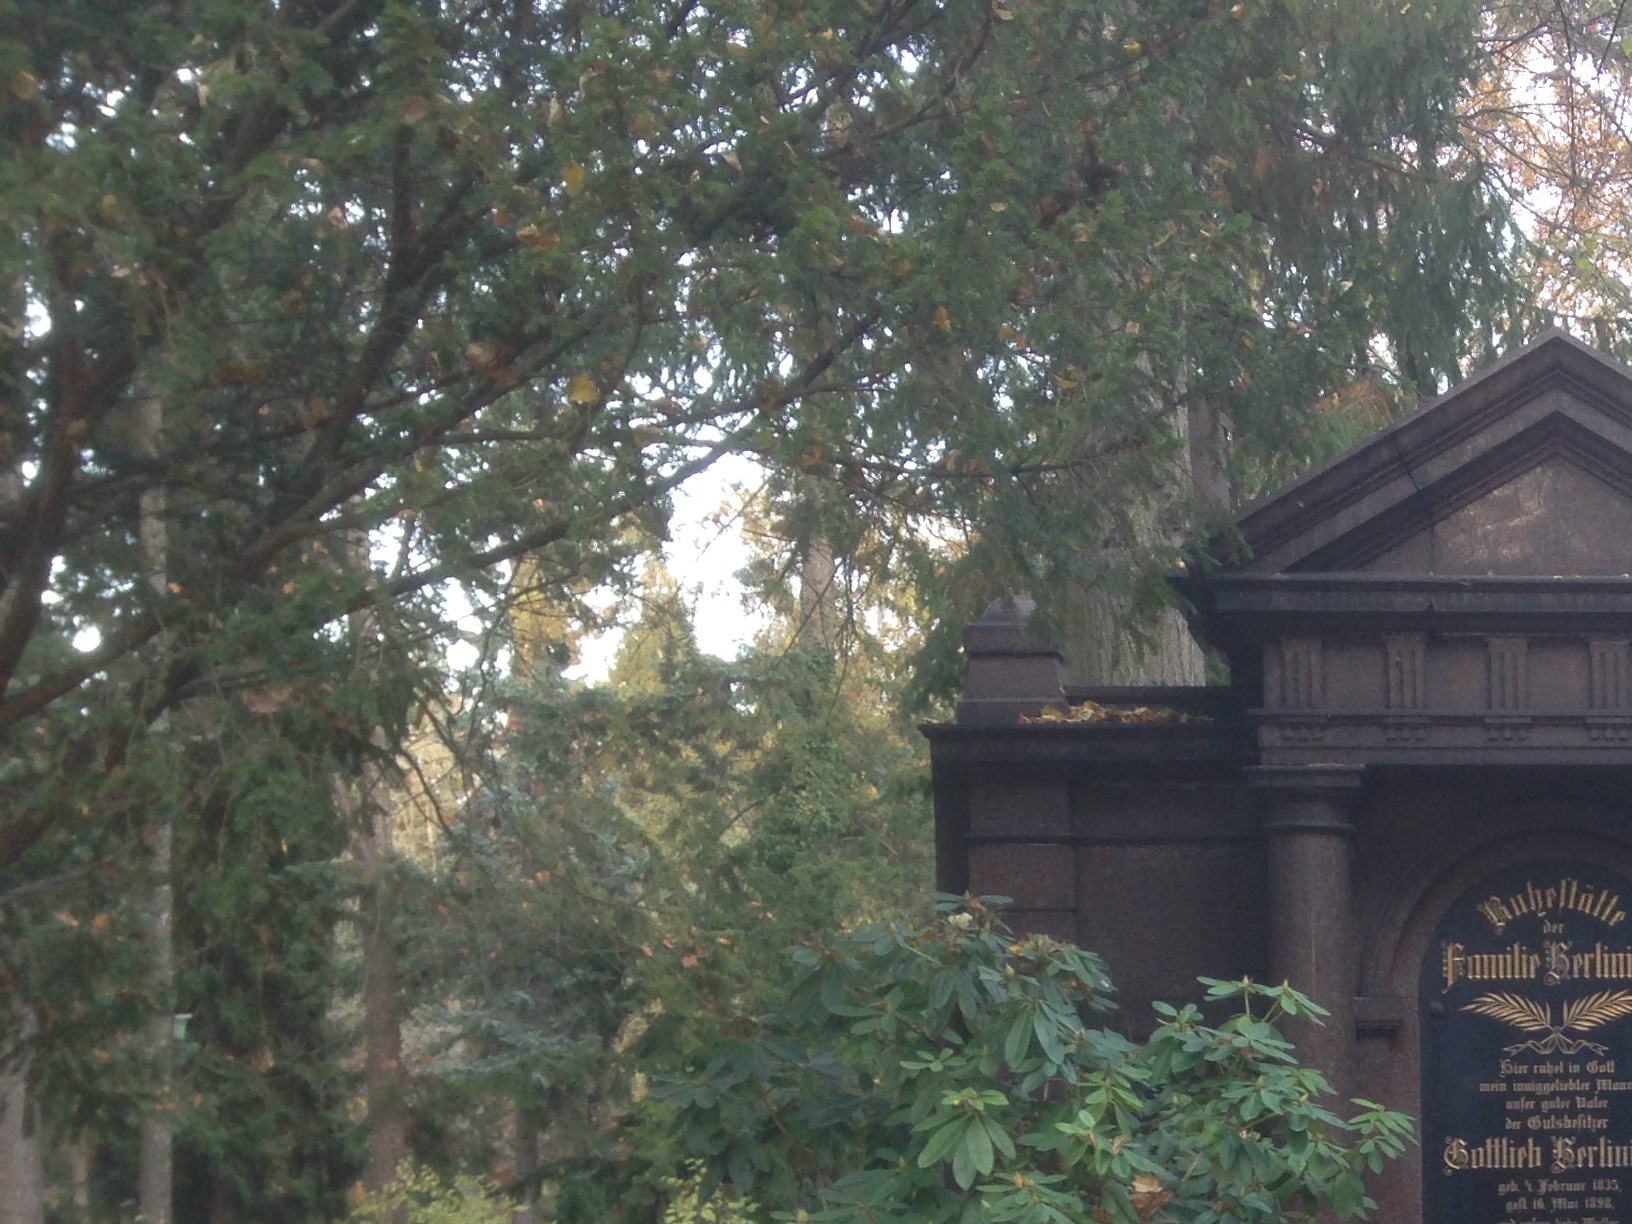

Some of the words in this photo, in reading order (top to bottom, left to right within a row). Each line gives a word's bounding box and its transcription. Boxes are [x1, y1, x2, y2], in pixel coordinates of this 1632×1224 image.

[1542, 920, 1564, 934] der
[1440, 940, 1541, 994] Familie
[1500, 1058, 1529, 1078] Hier
[1569, 1062, 1580, 1074] in
[1586, 1060, 1615, 1074] Gott
[1479, 1080, 1507, 1092] mein
[1506, 1096, 1536, 1112] unser
[1541, 1096, 1571, 1113] guter
[1505, 1117, 1522, 1130] der
[1527, 1114, 1609, 1132] Gutsbesitzer
[1443, 1135, 1543, 1177] Gottlieb
[1537, 1178, 1586, 1196] Februar
[1550, 1197, 1579, 1214] Mai
